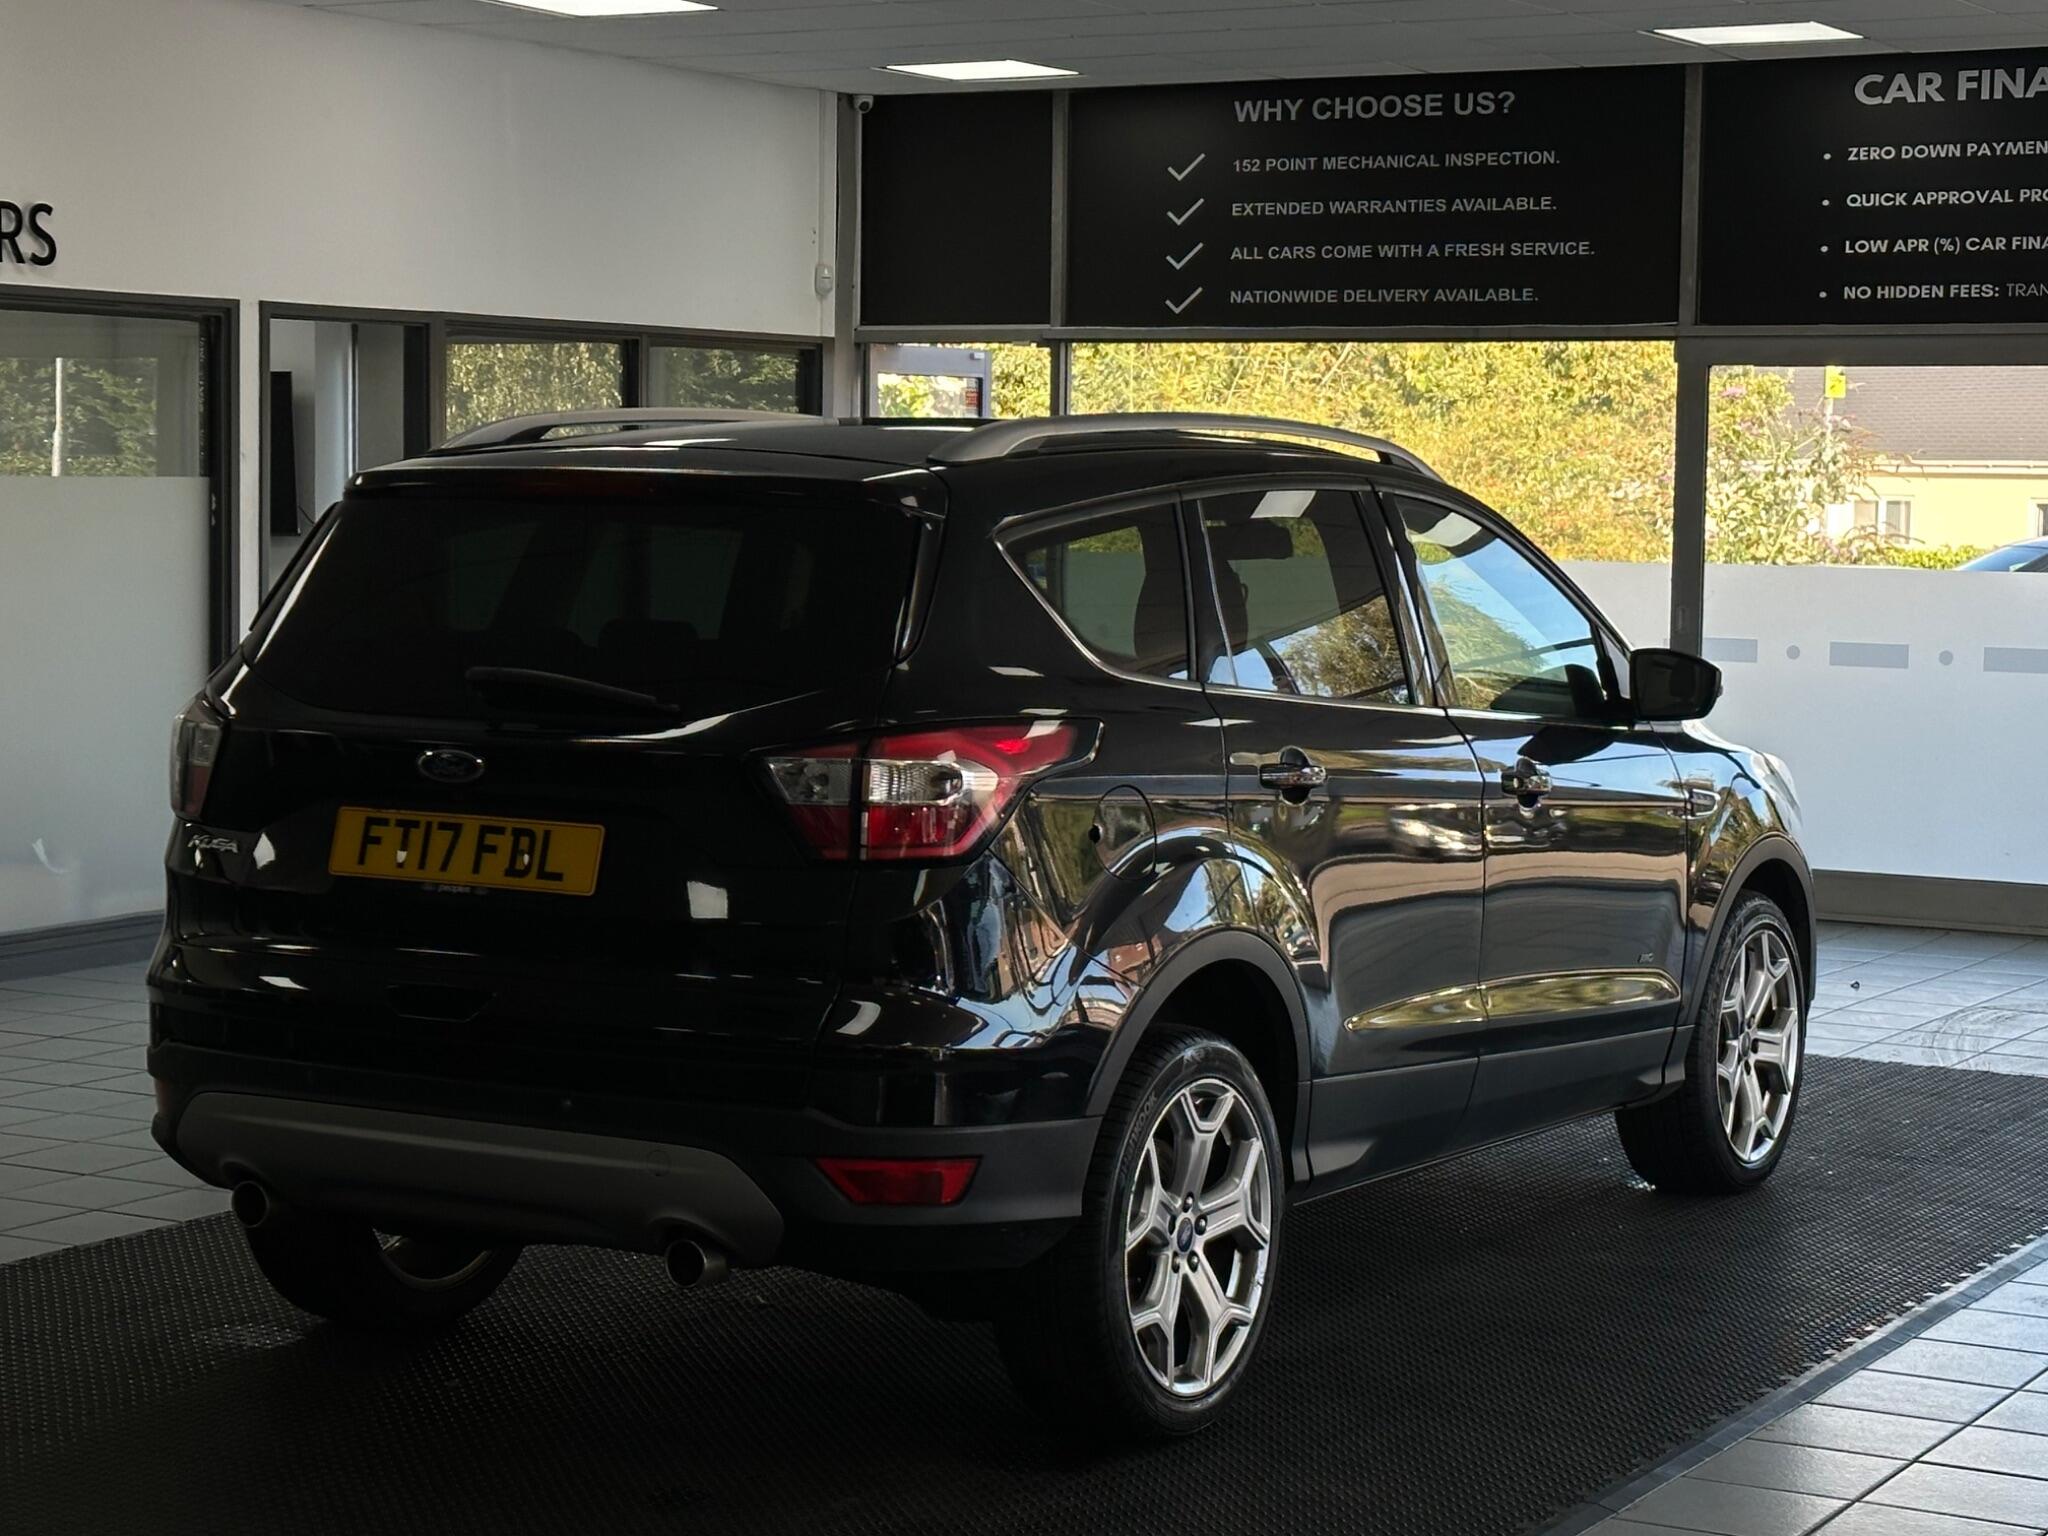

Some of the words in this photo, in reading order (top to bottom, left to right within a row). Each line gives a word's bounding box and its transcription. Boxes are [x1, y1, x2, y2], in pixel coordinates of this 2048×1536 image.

[1854, 72, 1945, 105] CAR
[1957, 67, 2048, 101] FINA
[1234, 99, 1303, 122] WHY
[1312, 94, 1443, 120] CHOOSE
[1455, 91, 1515, 115] US?
[1848, 146, 1895, 160] ZERO
[1901, 144, 1960, 158] DOWN
[1967, 141, 2048, 156] PAYMEN
[1234, 159, 1260, 172] 152
[1266, 157, 1317, 171] POINT
[1323, 154, 1440, 170] MECHANICAL
[1445, 151, 1560, 166] INSPECTION.
[1232, 202, 1323, 216] EXTENDED
[1329, 199, 1446, 214] WARRANTIES
[1451, 197, 1556, 211] AVAILABLE.
[1847, 193, 1907, 207] QUICK
[1912, 190, 2013, 205] APPROVAL
[0, 200, 57, 266] RS
[1231, 247, 1263, 260] ALL
[1268, 246, 1315, 259] CARS
[1322, 245, 1372, 258] COME
[1378, 244, 1422, 257] WITH
[1427, 244, 1440, 257] A
[1445, 243, 1504, 256] FRESH
[1511, 242, 1594, 256] SERVICE.
[1845, 240, 1888, 253] LOW
[1893, 239, 1929, 252] APR
[1934, 237, 1960, 255] (%)
[1966, 237, 2006, 251] CAR
[1231, 290, 1337, 303] NATIONWIDE
[1344, 289, 1429, 302] DELIVERY
[1434, 288, 1538, 301] AVAILABLE.
[1844, 286, 1871, 299] NO
[1877, 285, 1944, 299] HIDDEN
[1950, 284, 1999, 297] FEES:
[357, 816, 464, 870] FT17
